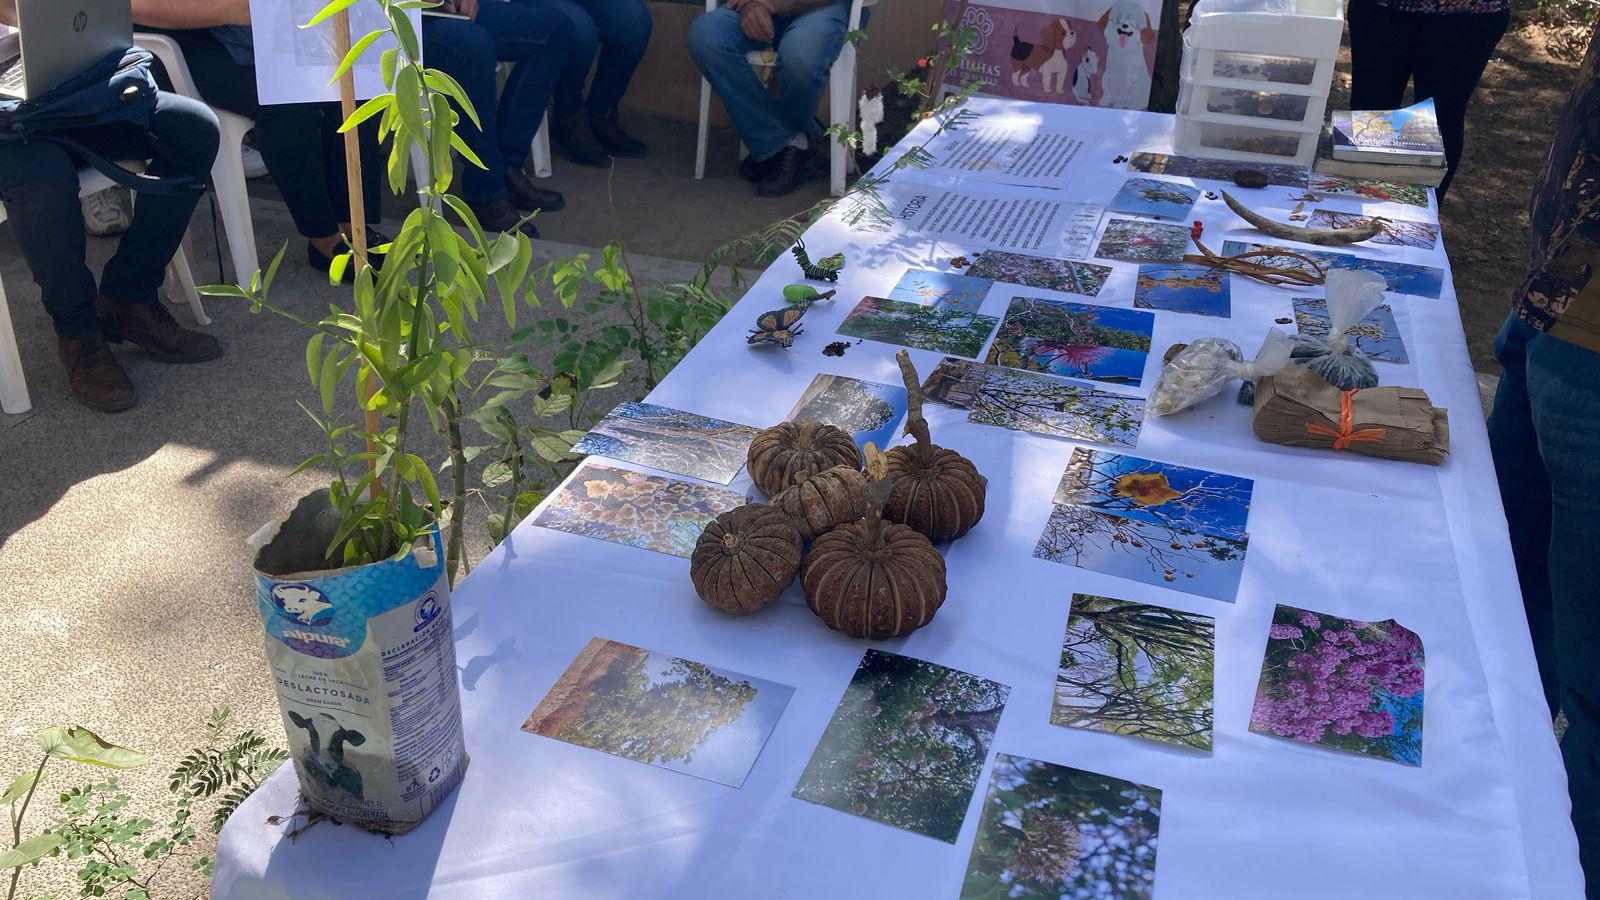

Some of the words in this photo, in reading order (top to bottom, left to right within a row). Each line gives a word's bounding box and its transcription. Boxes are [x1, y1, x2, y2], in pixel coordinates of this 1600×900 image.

[898, 194, 928, 221] HISTORIA
[282, 629, 351, 648] alpura
[276, 676, 370, 705] DESLACTOSADA
